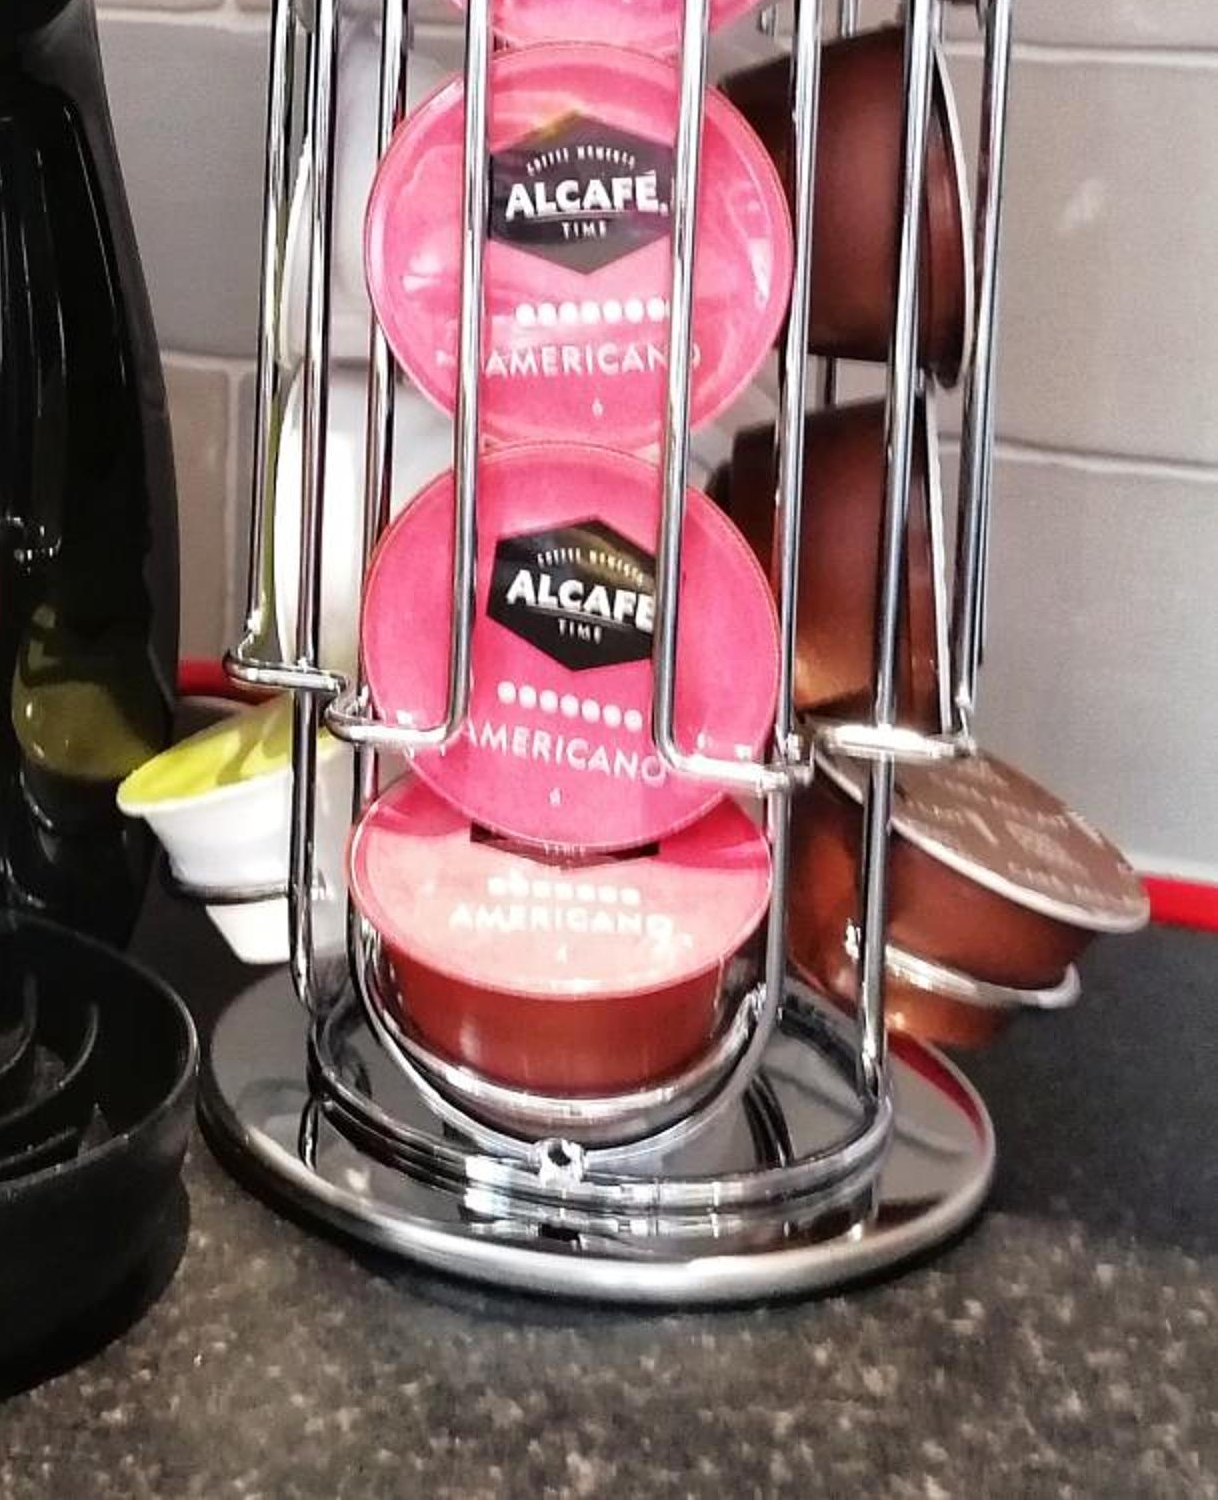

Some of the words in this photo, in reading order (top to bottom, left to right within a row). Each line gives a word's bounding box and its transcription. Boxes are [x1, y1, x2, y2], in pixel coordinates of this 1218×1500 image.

[561, 221, 608, 240] TIME
[486, 341, 702, 379] AMERICAN
[557, 618, 602, 645] TIME
[447, 902, 675, 938] AMERICANO
